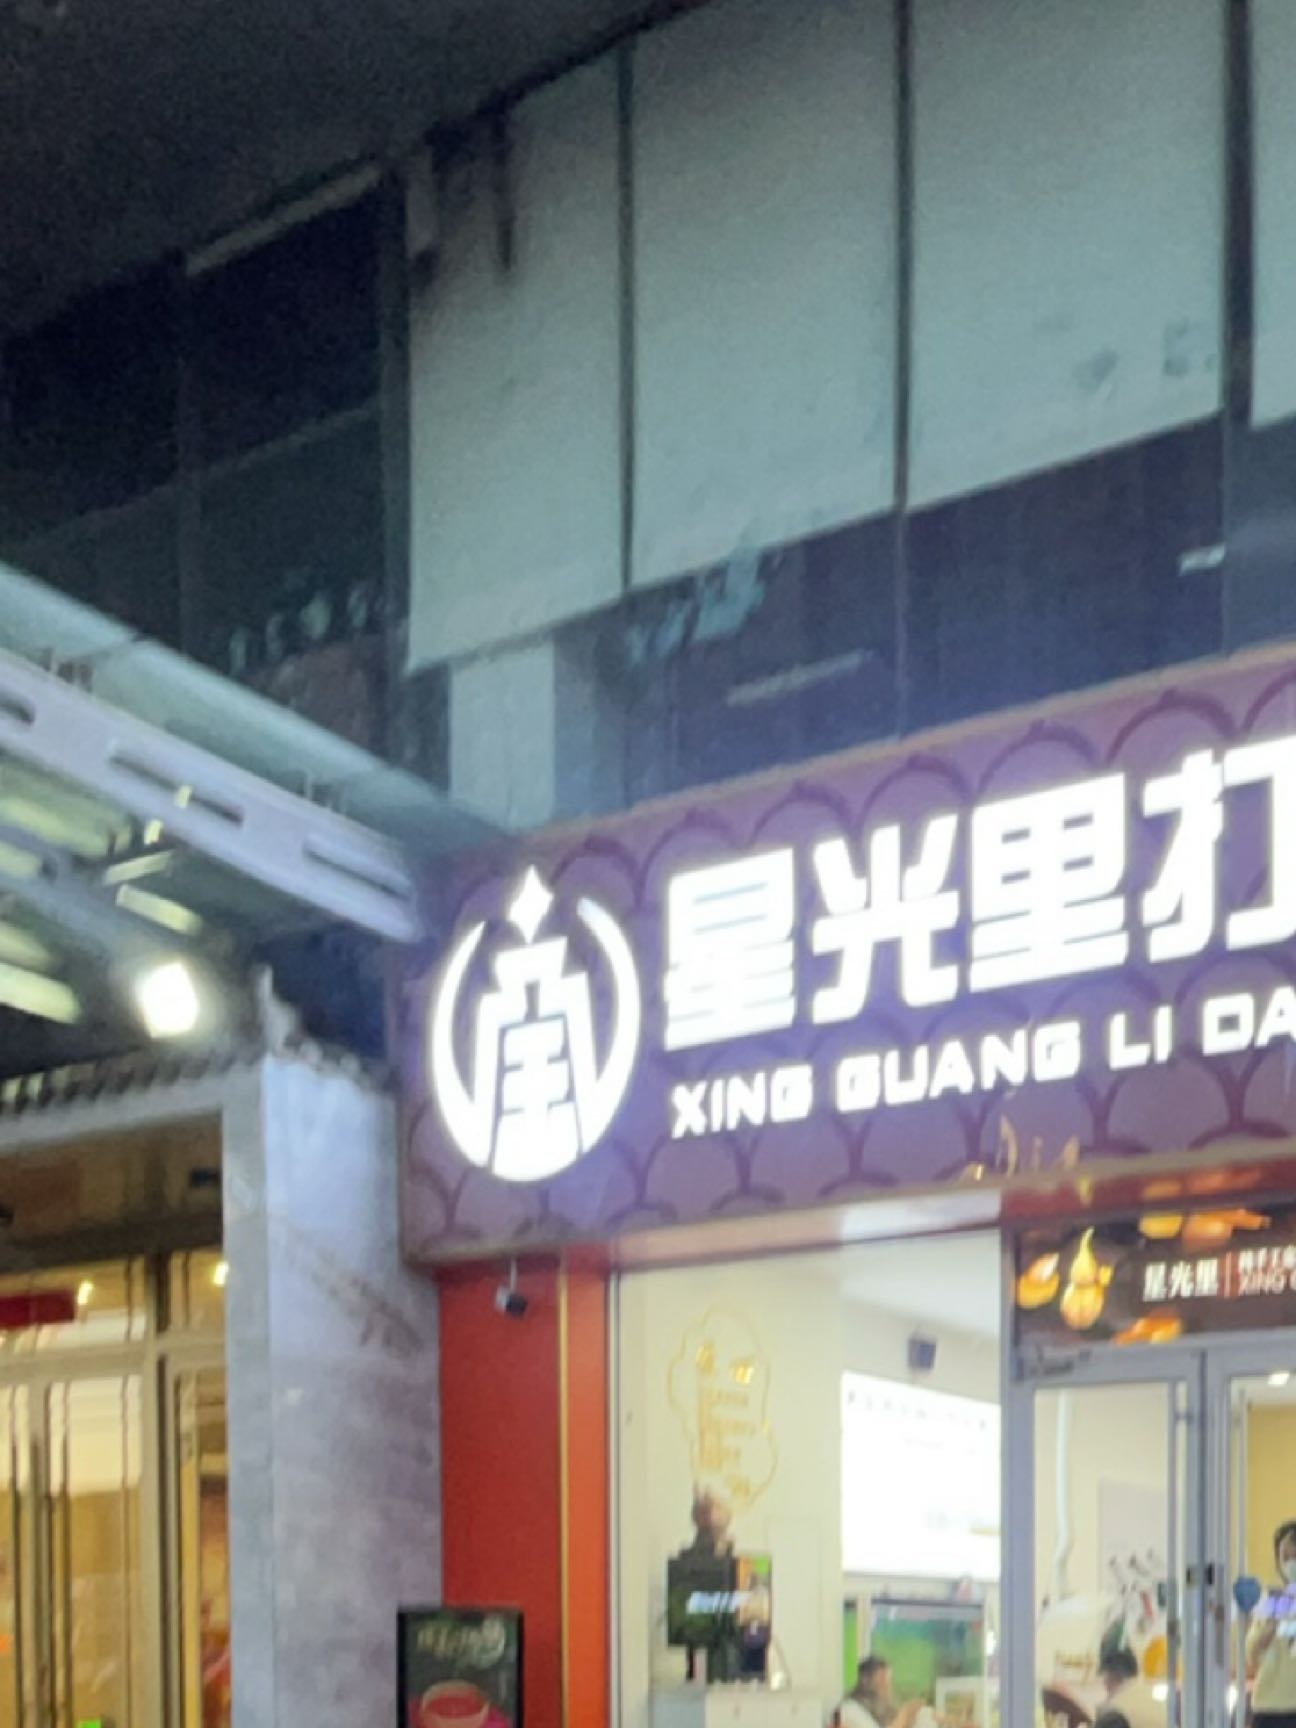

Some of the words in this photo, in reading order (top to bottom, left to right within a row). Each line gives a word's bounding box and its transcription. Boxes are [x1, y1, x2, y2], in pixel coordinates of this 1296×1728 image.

[671, 1064, 812, 1139] XING
[836, 1020, 1080, 1112] GUANG
[1108, 1004, 1172, 1070] LI
[1143, 1258, 1219, 1302] 星光里
